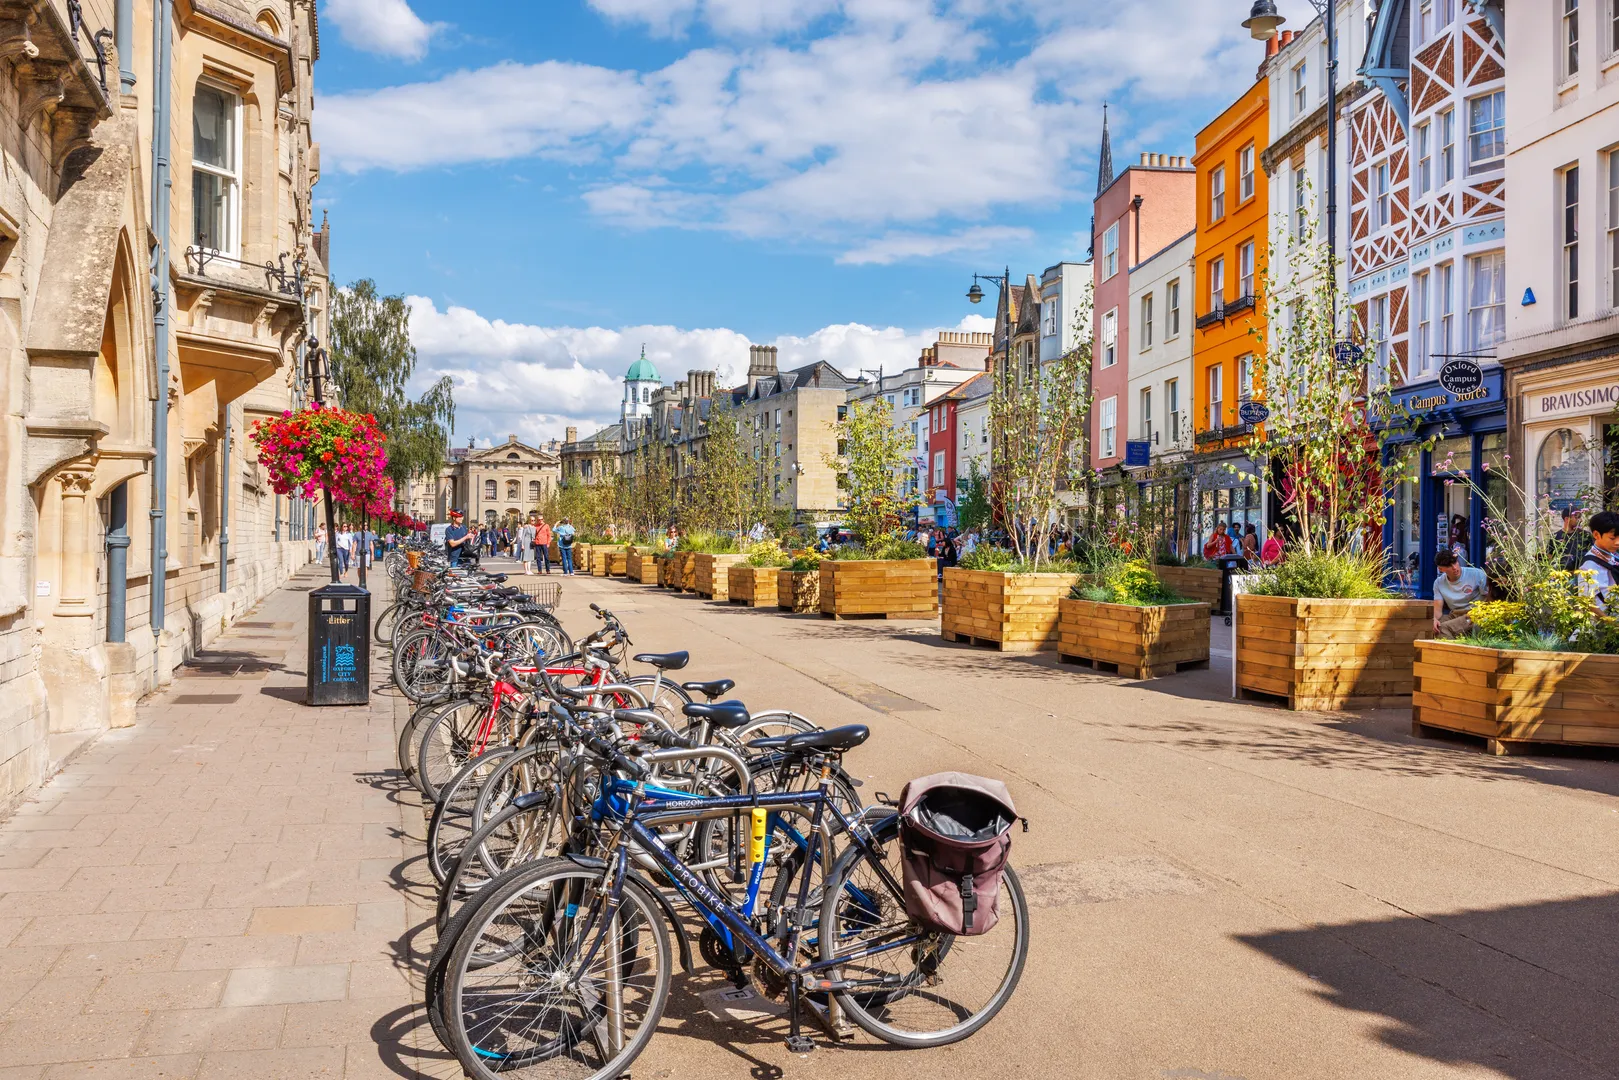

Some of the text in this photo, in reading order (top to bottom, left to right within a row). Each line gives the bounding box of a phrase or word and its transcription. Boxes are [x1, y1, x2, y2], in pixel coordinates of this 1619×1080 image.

[1444, 361, 1478, 374] Oxford
[1443, 374, 1477, 383] Campus
[1447, 382, 1477, 393] Stores
[1410, 394, 1447, 411] Campus
[1542, 385, 1619, 412] BRAVISSIMO
[666, 799, 704, 808] HORIZON
[673, 863, 725, 912] PROBIKE
